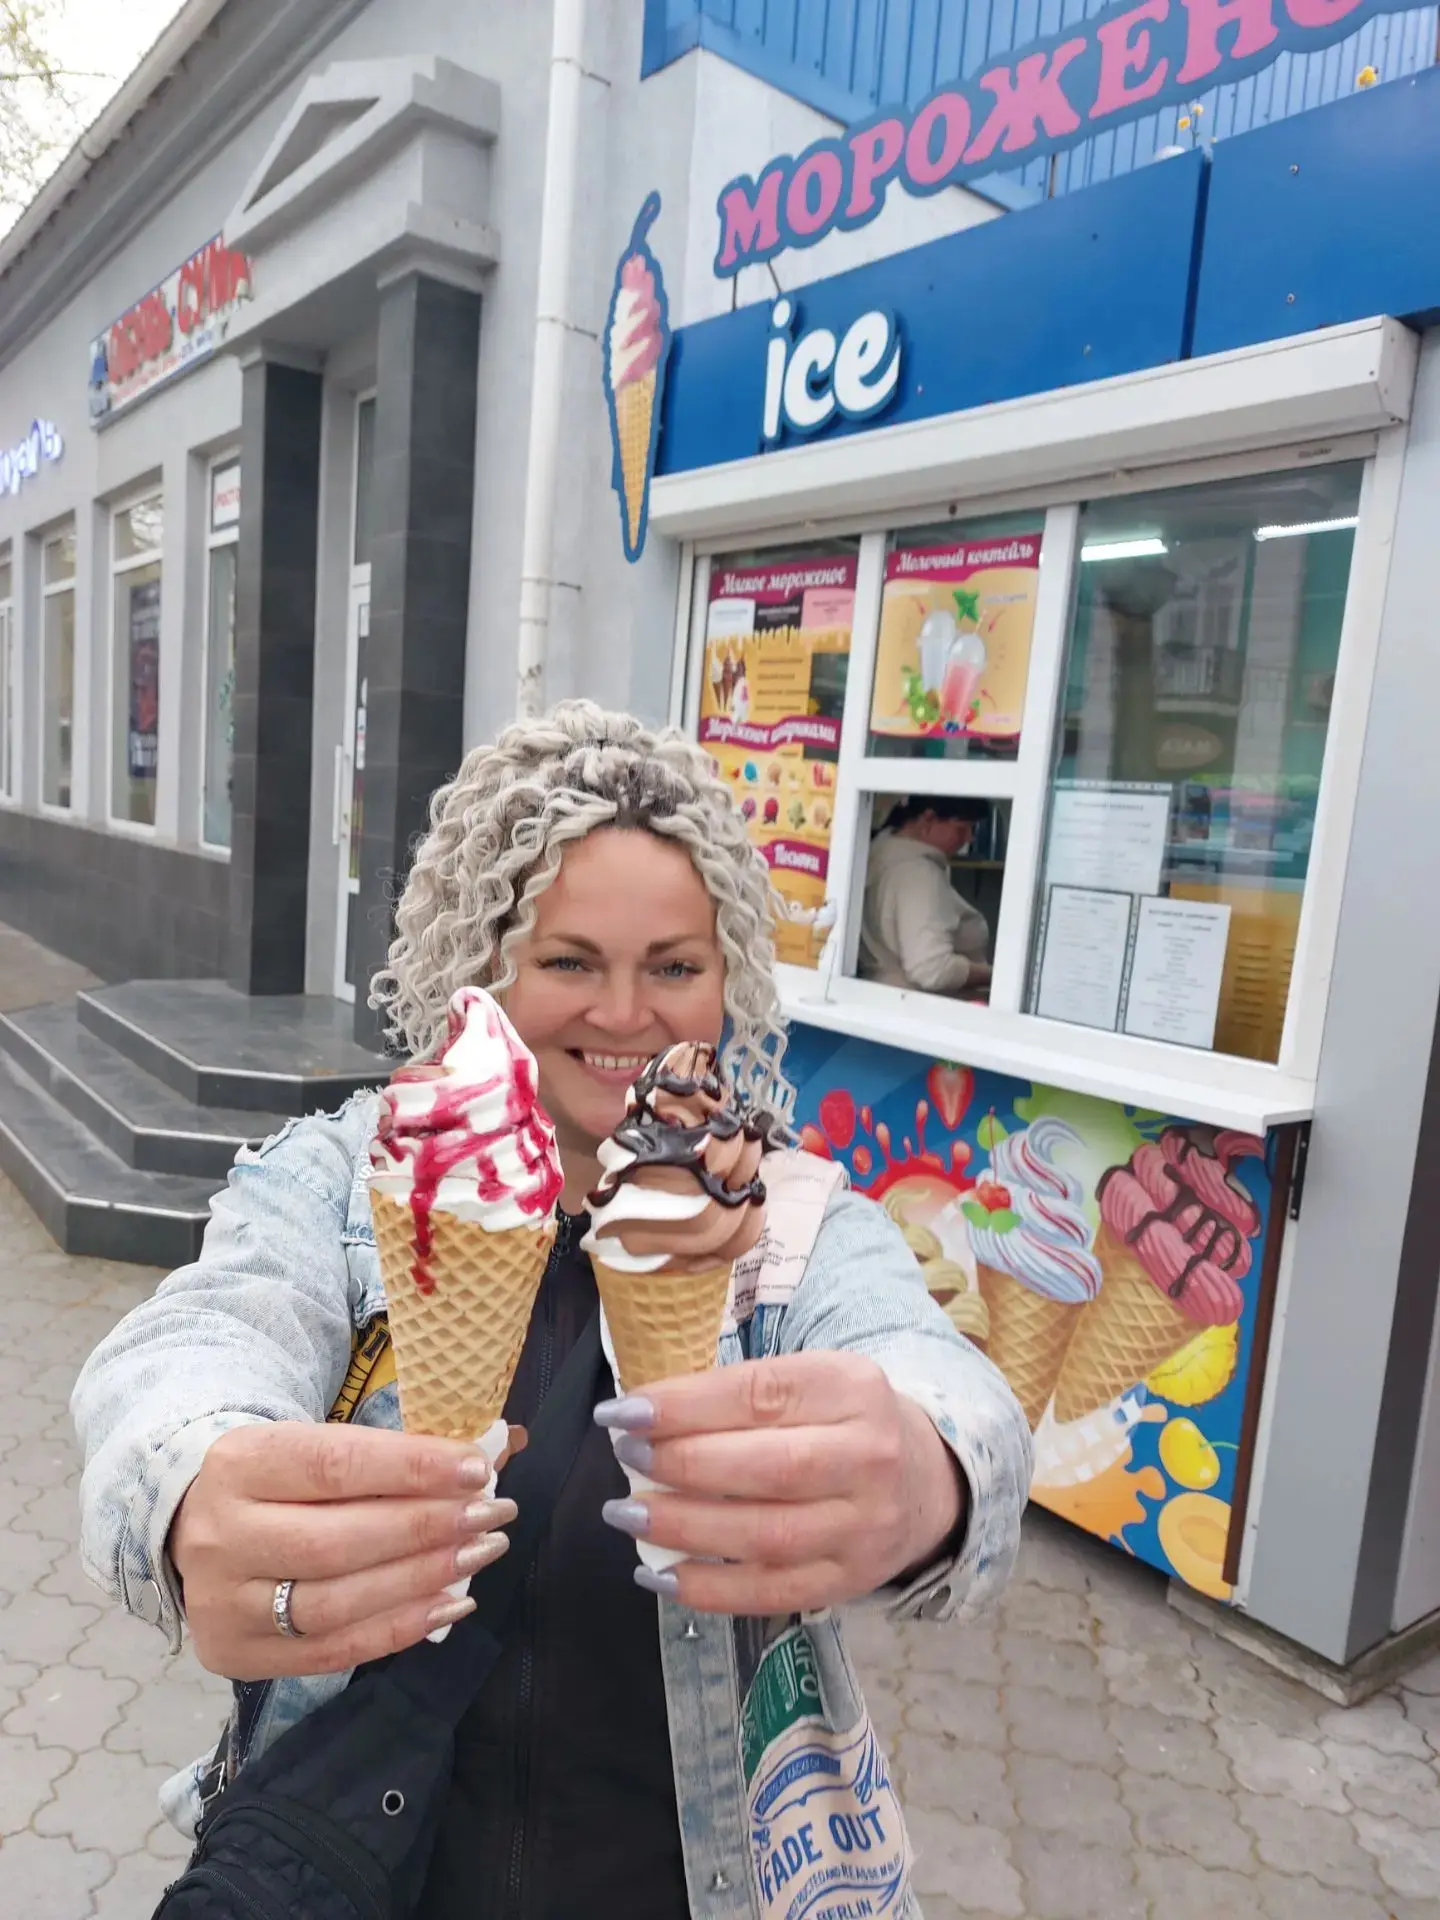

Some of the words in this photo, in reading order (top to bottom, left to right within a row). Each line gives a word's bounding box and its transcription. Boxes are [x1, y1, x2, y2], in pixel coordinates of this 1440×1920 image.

[762, 298, 902, 441] ice
[762, 1822, 823, 1906] FADE
[828, 1805, 886, 1853] OUT
[816, 1896, 873, 1920] BERLIN
